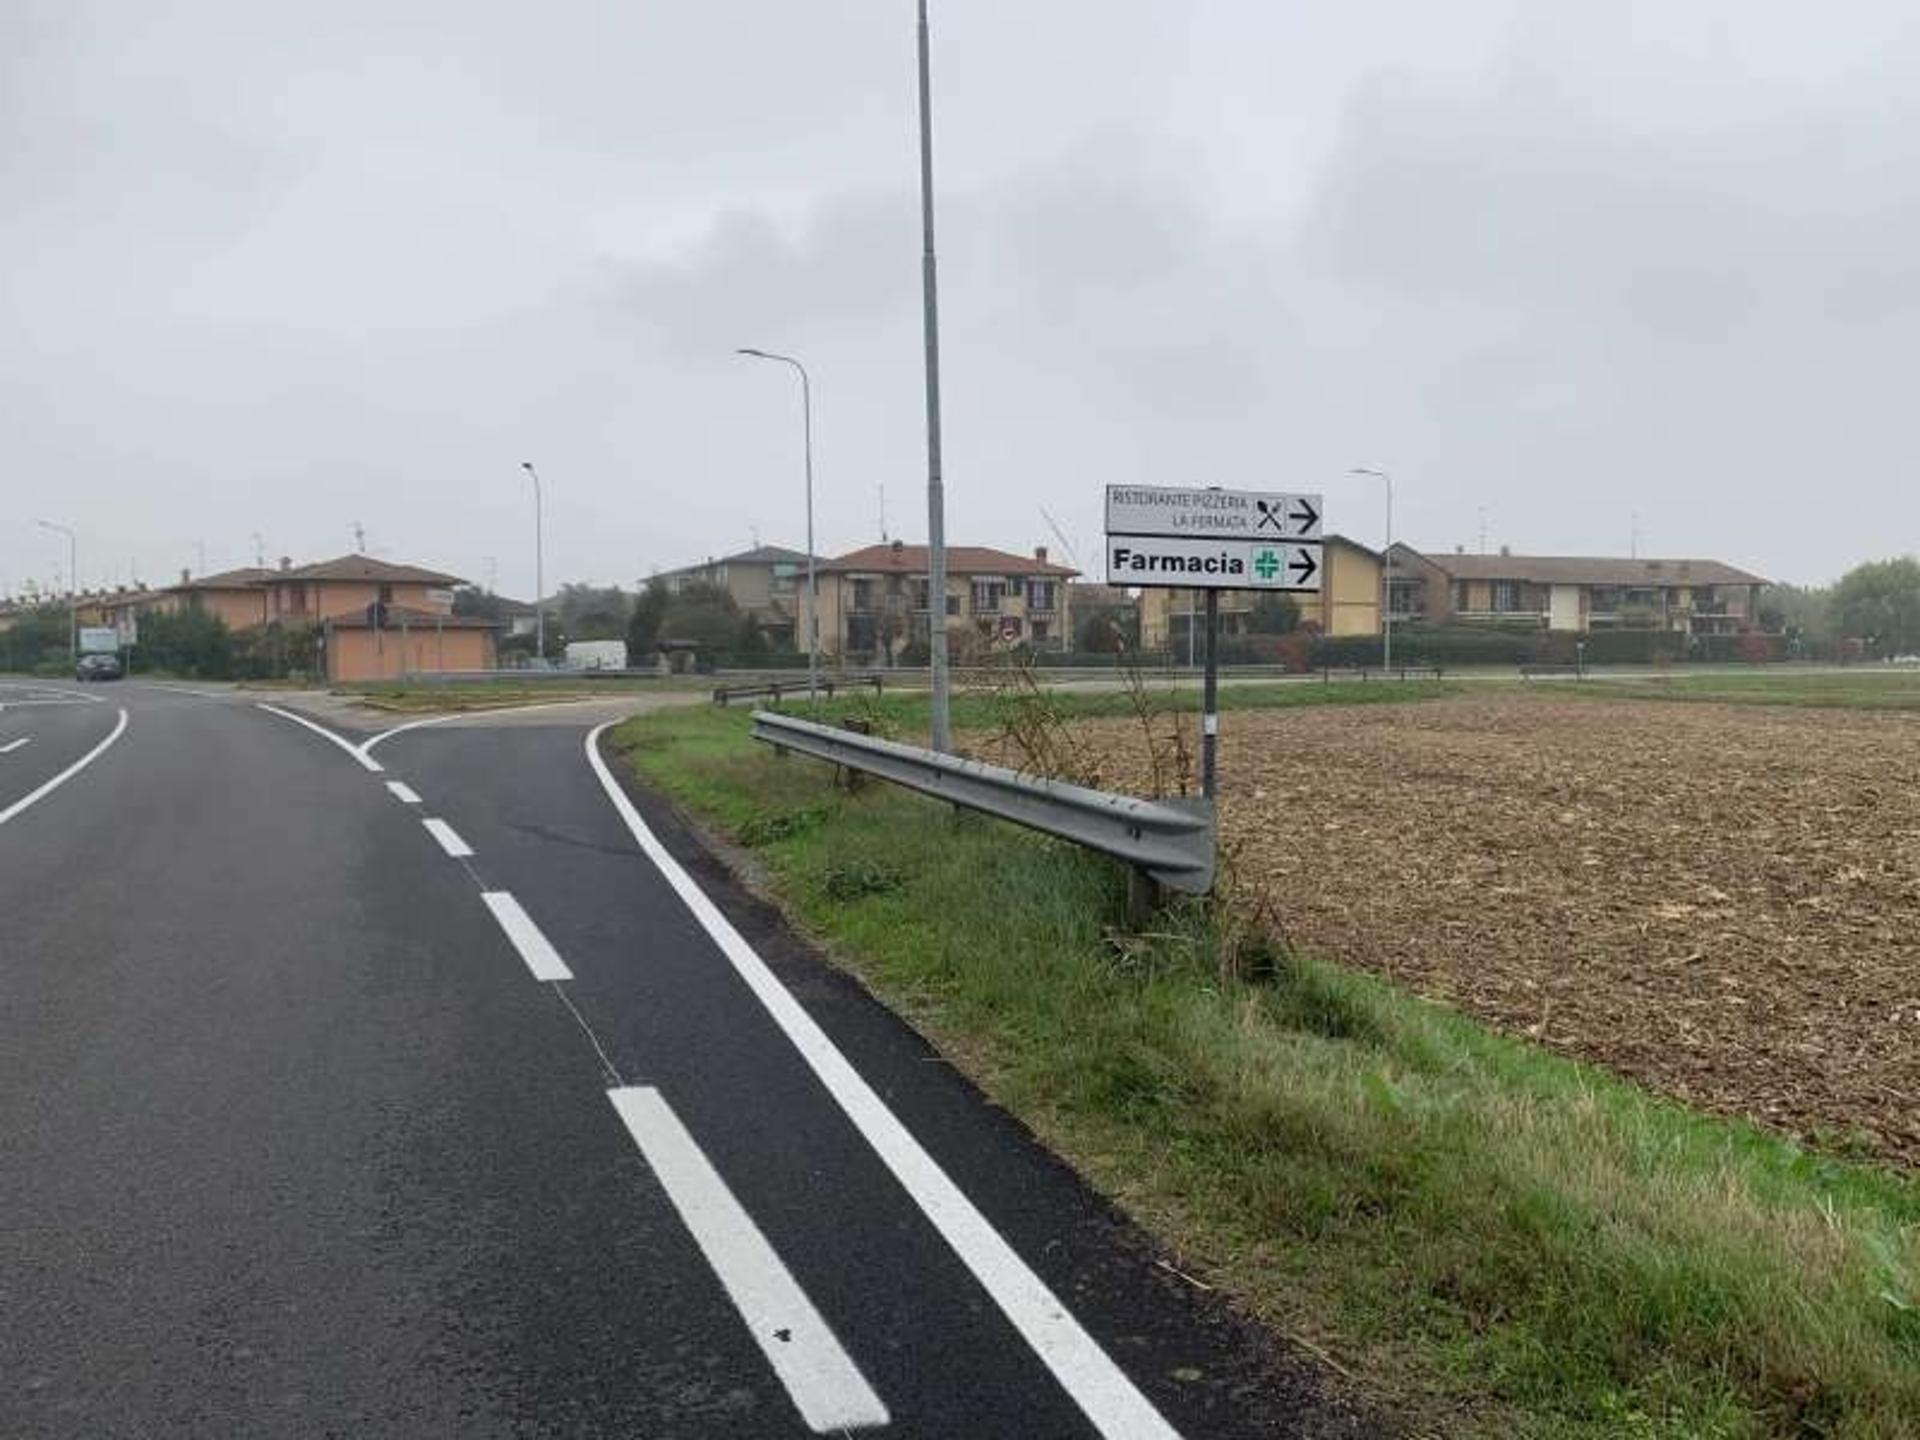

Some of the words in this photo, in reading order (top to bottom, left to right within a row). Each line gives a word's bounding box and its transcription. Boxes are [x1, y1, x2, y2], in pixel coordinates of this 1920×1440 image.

[1113, 490, 1190, 506] RISTORANTE
[1192, 493, 1248, 509] PIZZERIA
[1172, 516, 1190, 528] LA
[1192, 516, 1247, 529] FERMATA
[1113, 549, 1244, 574] Farmacia
